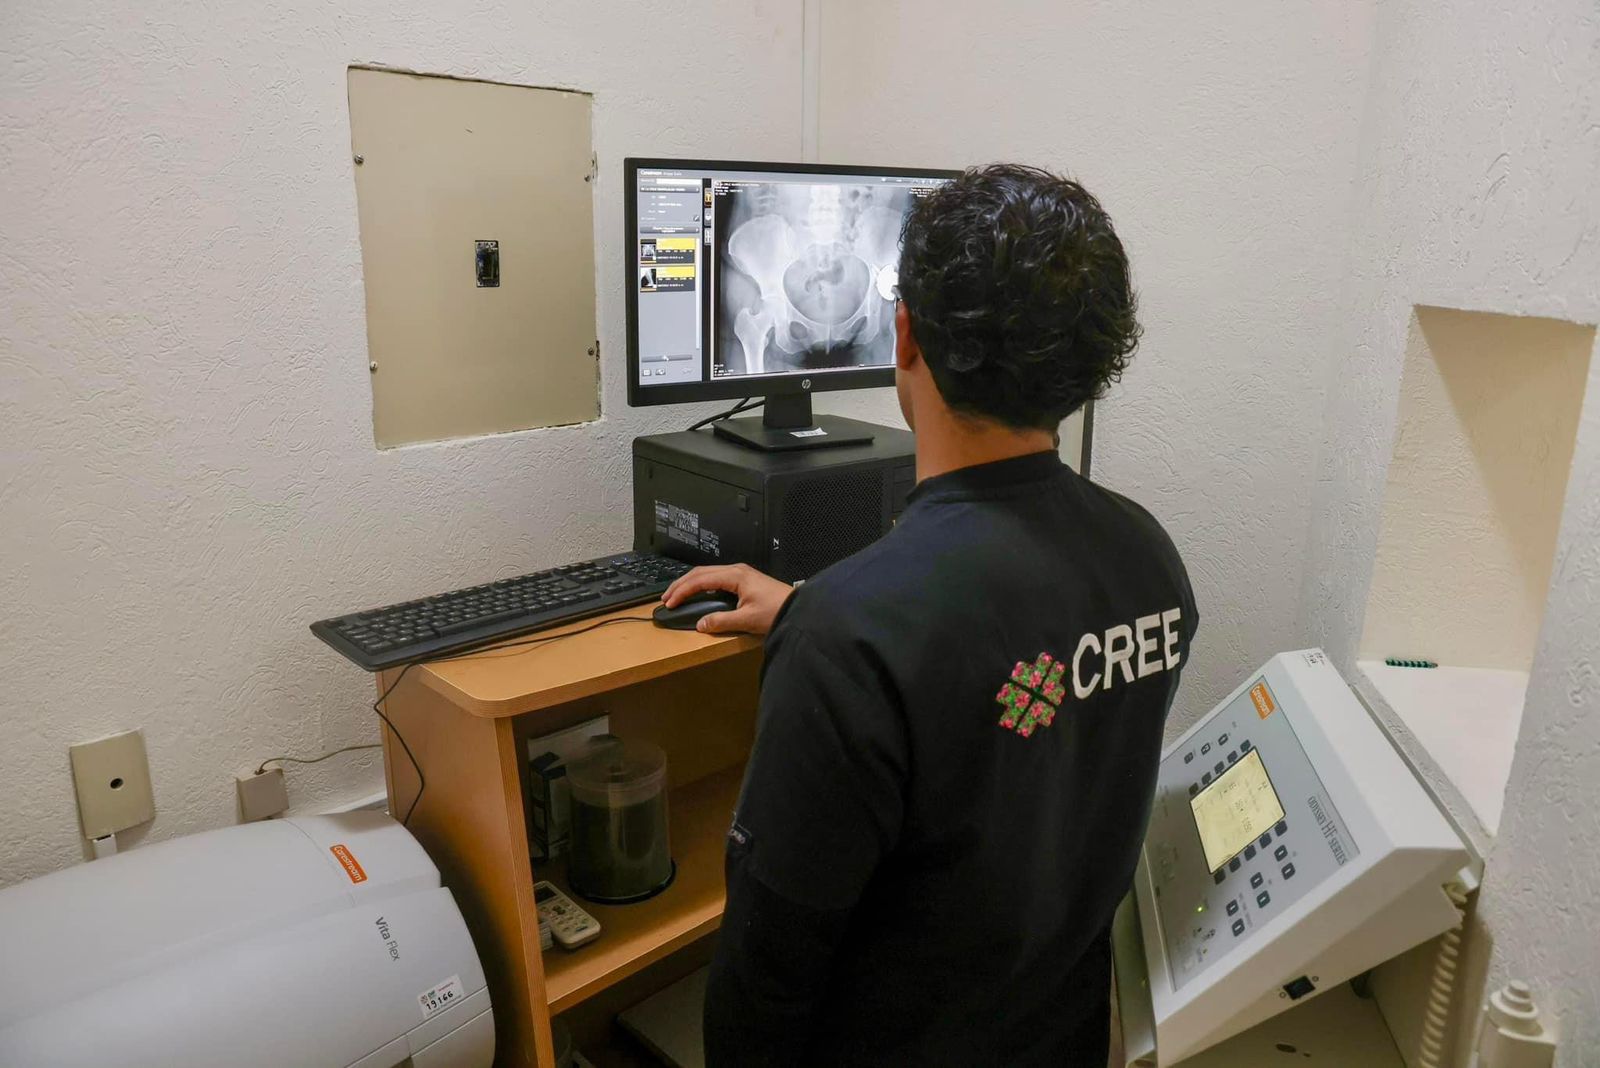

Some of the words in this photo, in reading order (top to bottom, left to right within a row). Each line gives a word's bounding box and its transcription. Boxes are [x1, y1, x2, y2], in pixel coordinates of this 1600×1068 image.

[1072, 607, 1181, 700] CREE
[1321, 820, 1338, 839] HF
[334, 846, 362, 881] Carestream
[1328, 838, 1348, 866] SERIES
[375, 917, 391, 941] Vita
[386, 940, 401, 962] Flex
[426, 990, 454, 1010] 19166
